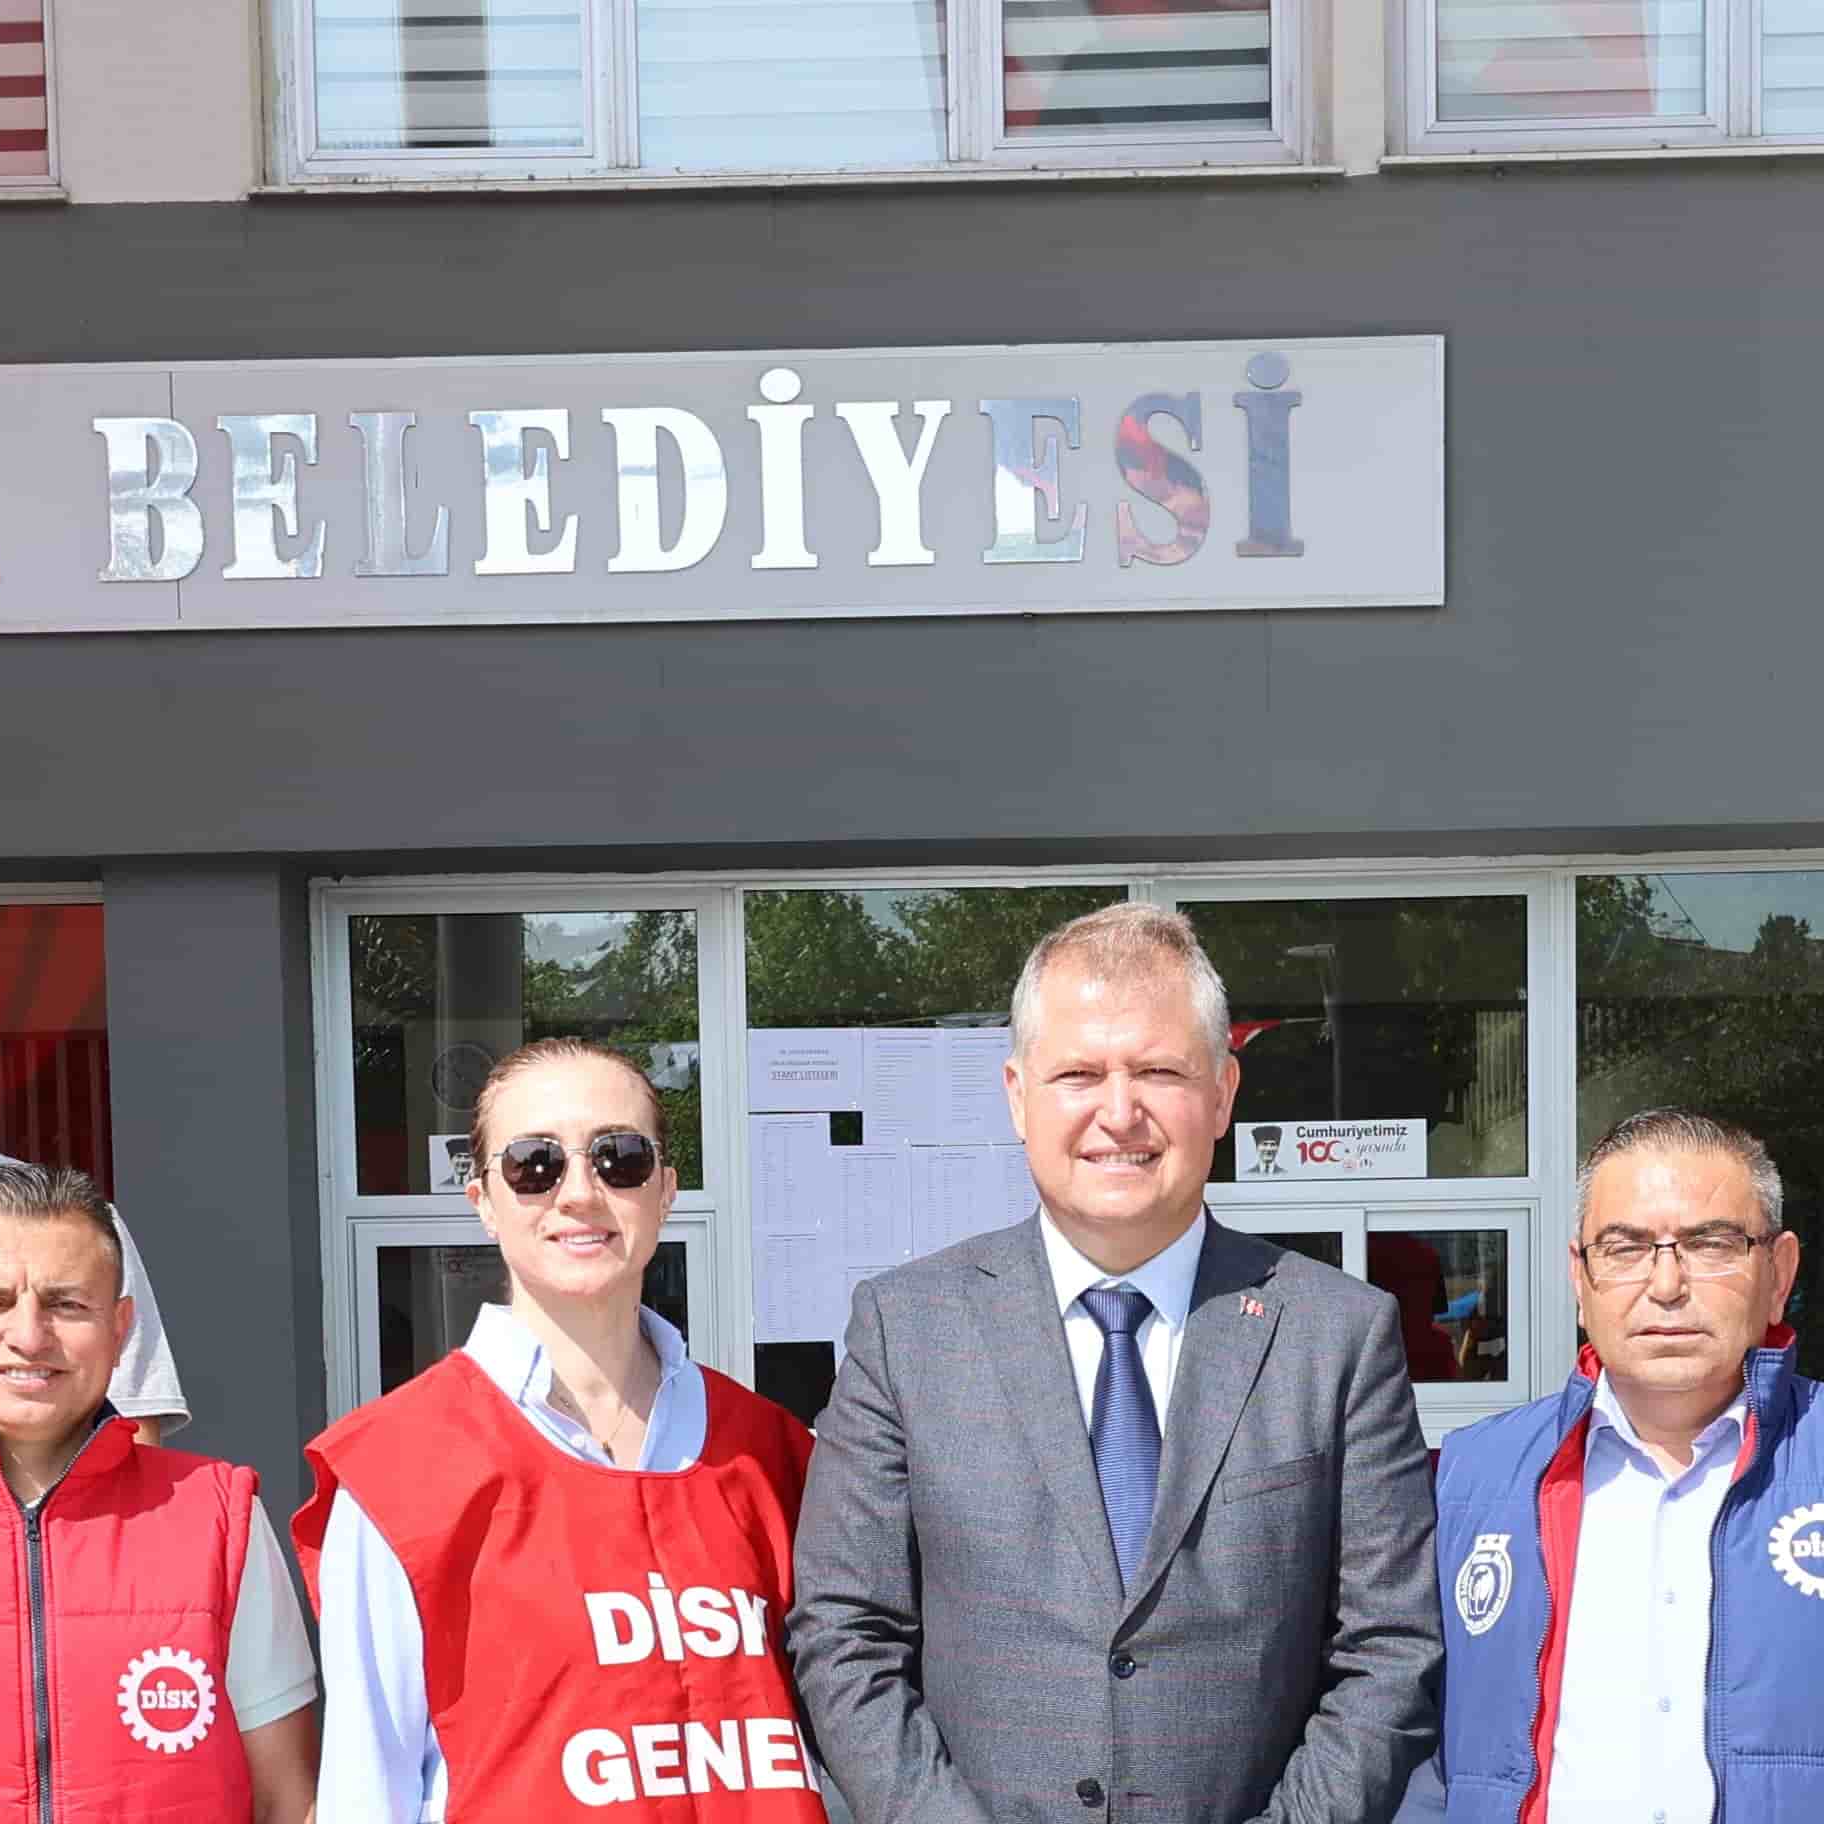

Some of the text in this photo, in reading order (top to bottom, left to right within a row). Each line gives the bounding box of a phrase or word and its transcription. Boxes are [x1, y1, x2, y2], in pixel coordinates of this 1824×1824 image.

[92, 350, 1306, 583] BELEDİYESİ
[1296, 1124, 1409, 1140] Cumhuriyetimiz
[140, 1679, 198, 1710] DİSK
